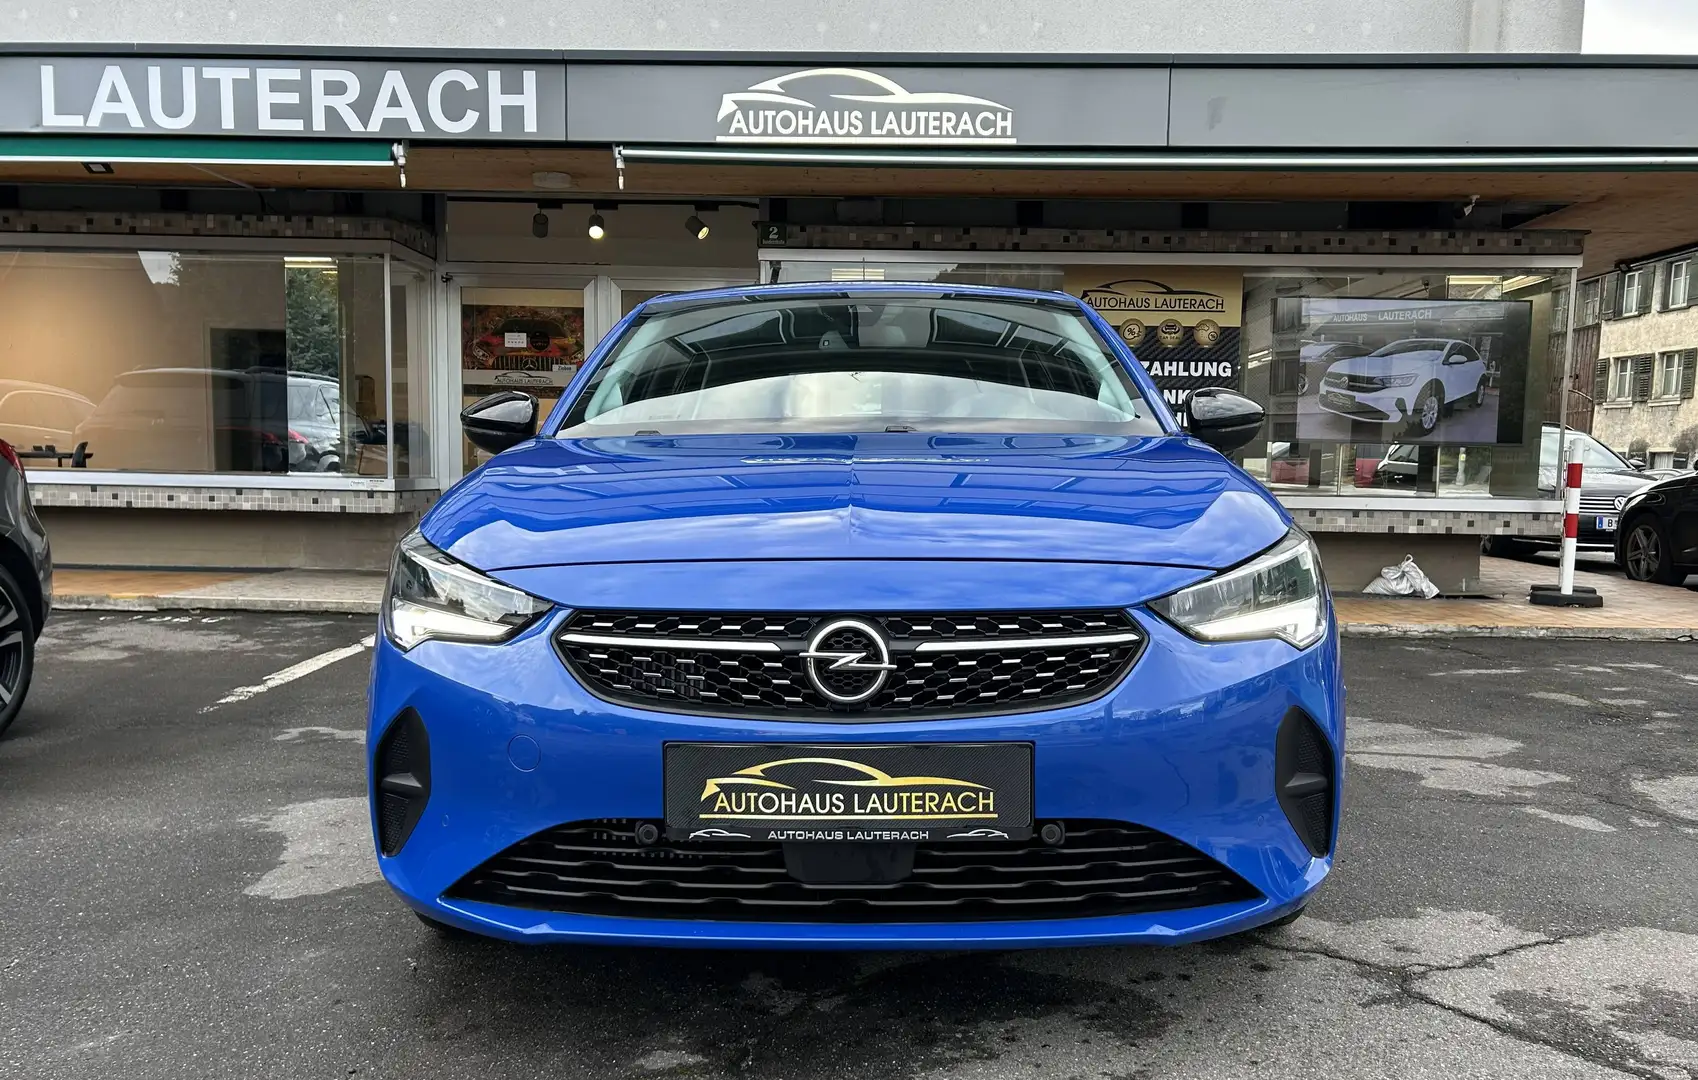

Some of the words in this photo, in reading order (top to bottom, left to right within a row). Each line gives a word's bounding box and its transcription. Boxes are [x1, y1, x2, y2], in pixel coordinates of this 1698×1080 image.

[40, 64, 538, 133] LAUTERACH
[728, 109, 864, 135] AUTOHAUS
[871, 110, 1013, 136] LAUTERACH
[769, 226, 779, 239] 2
[1086, 296, 1150, 309] AUTOHAUS
[1154, 297, 1224, 310] LAUTERACH
[1332, 312, 1368, 323] AUTOHAUS
[1377, 309, 1432, 321] LAUTERACH
[713, 791, 846, 814] AUTOHAUS
[853, 791, 995, 814] LAUTERACH
[767, 830, 844, 841] AUTOHAUS
[846, 830, 929, 841] LAUTERACH
